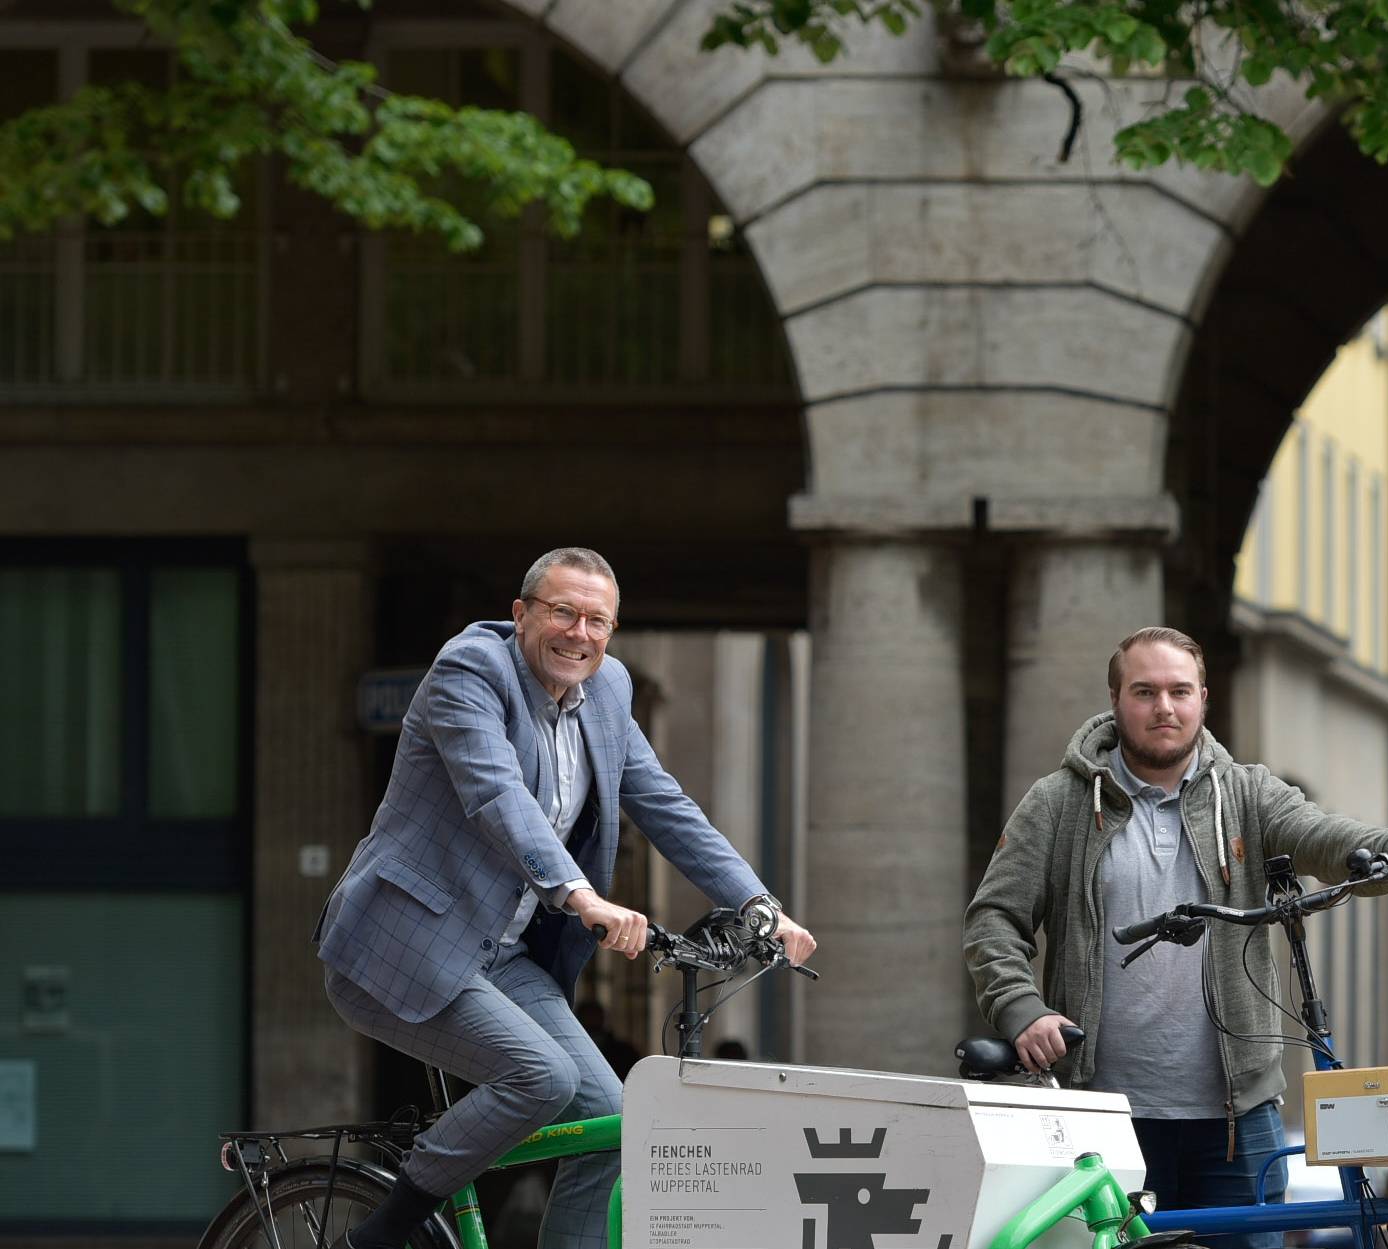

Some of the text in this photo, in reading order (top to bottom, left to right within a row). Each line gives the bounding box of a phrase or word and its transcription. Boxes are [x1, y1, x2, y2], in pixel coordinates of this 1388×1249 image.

[547, 1125, 585, 1138] KING
[650, 1145, 712, 1158] FIENCHEN
[650, 1162, 763, 1176] FREIES LASTENRAD
[650, 1179, 720, 1193] WUPPERTAL
